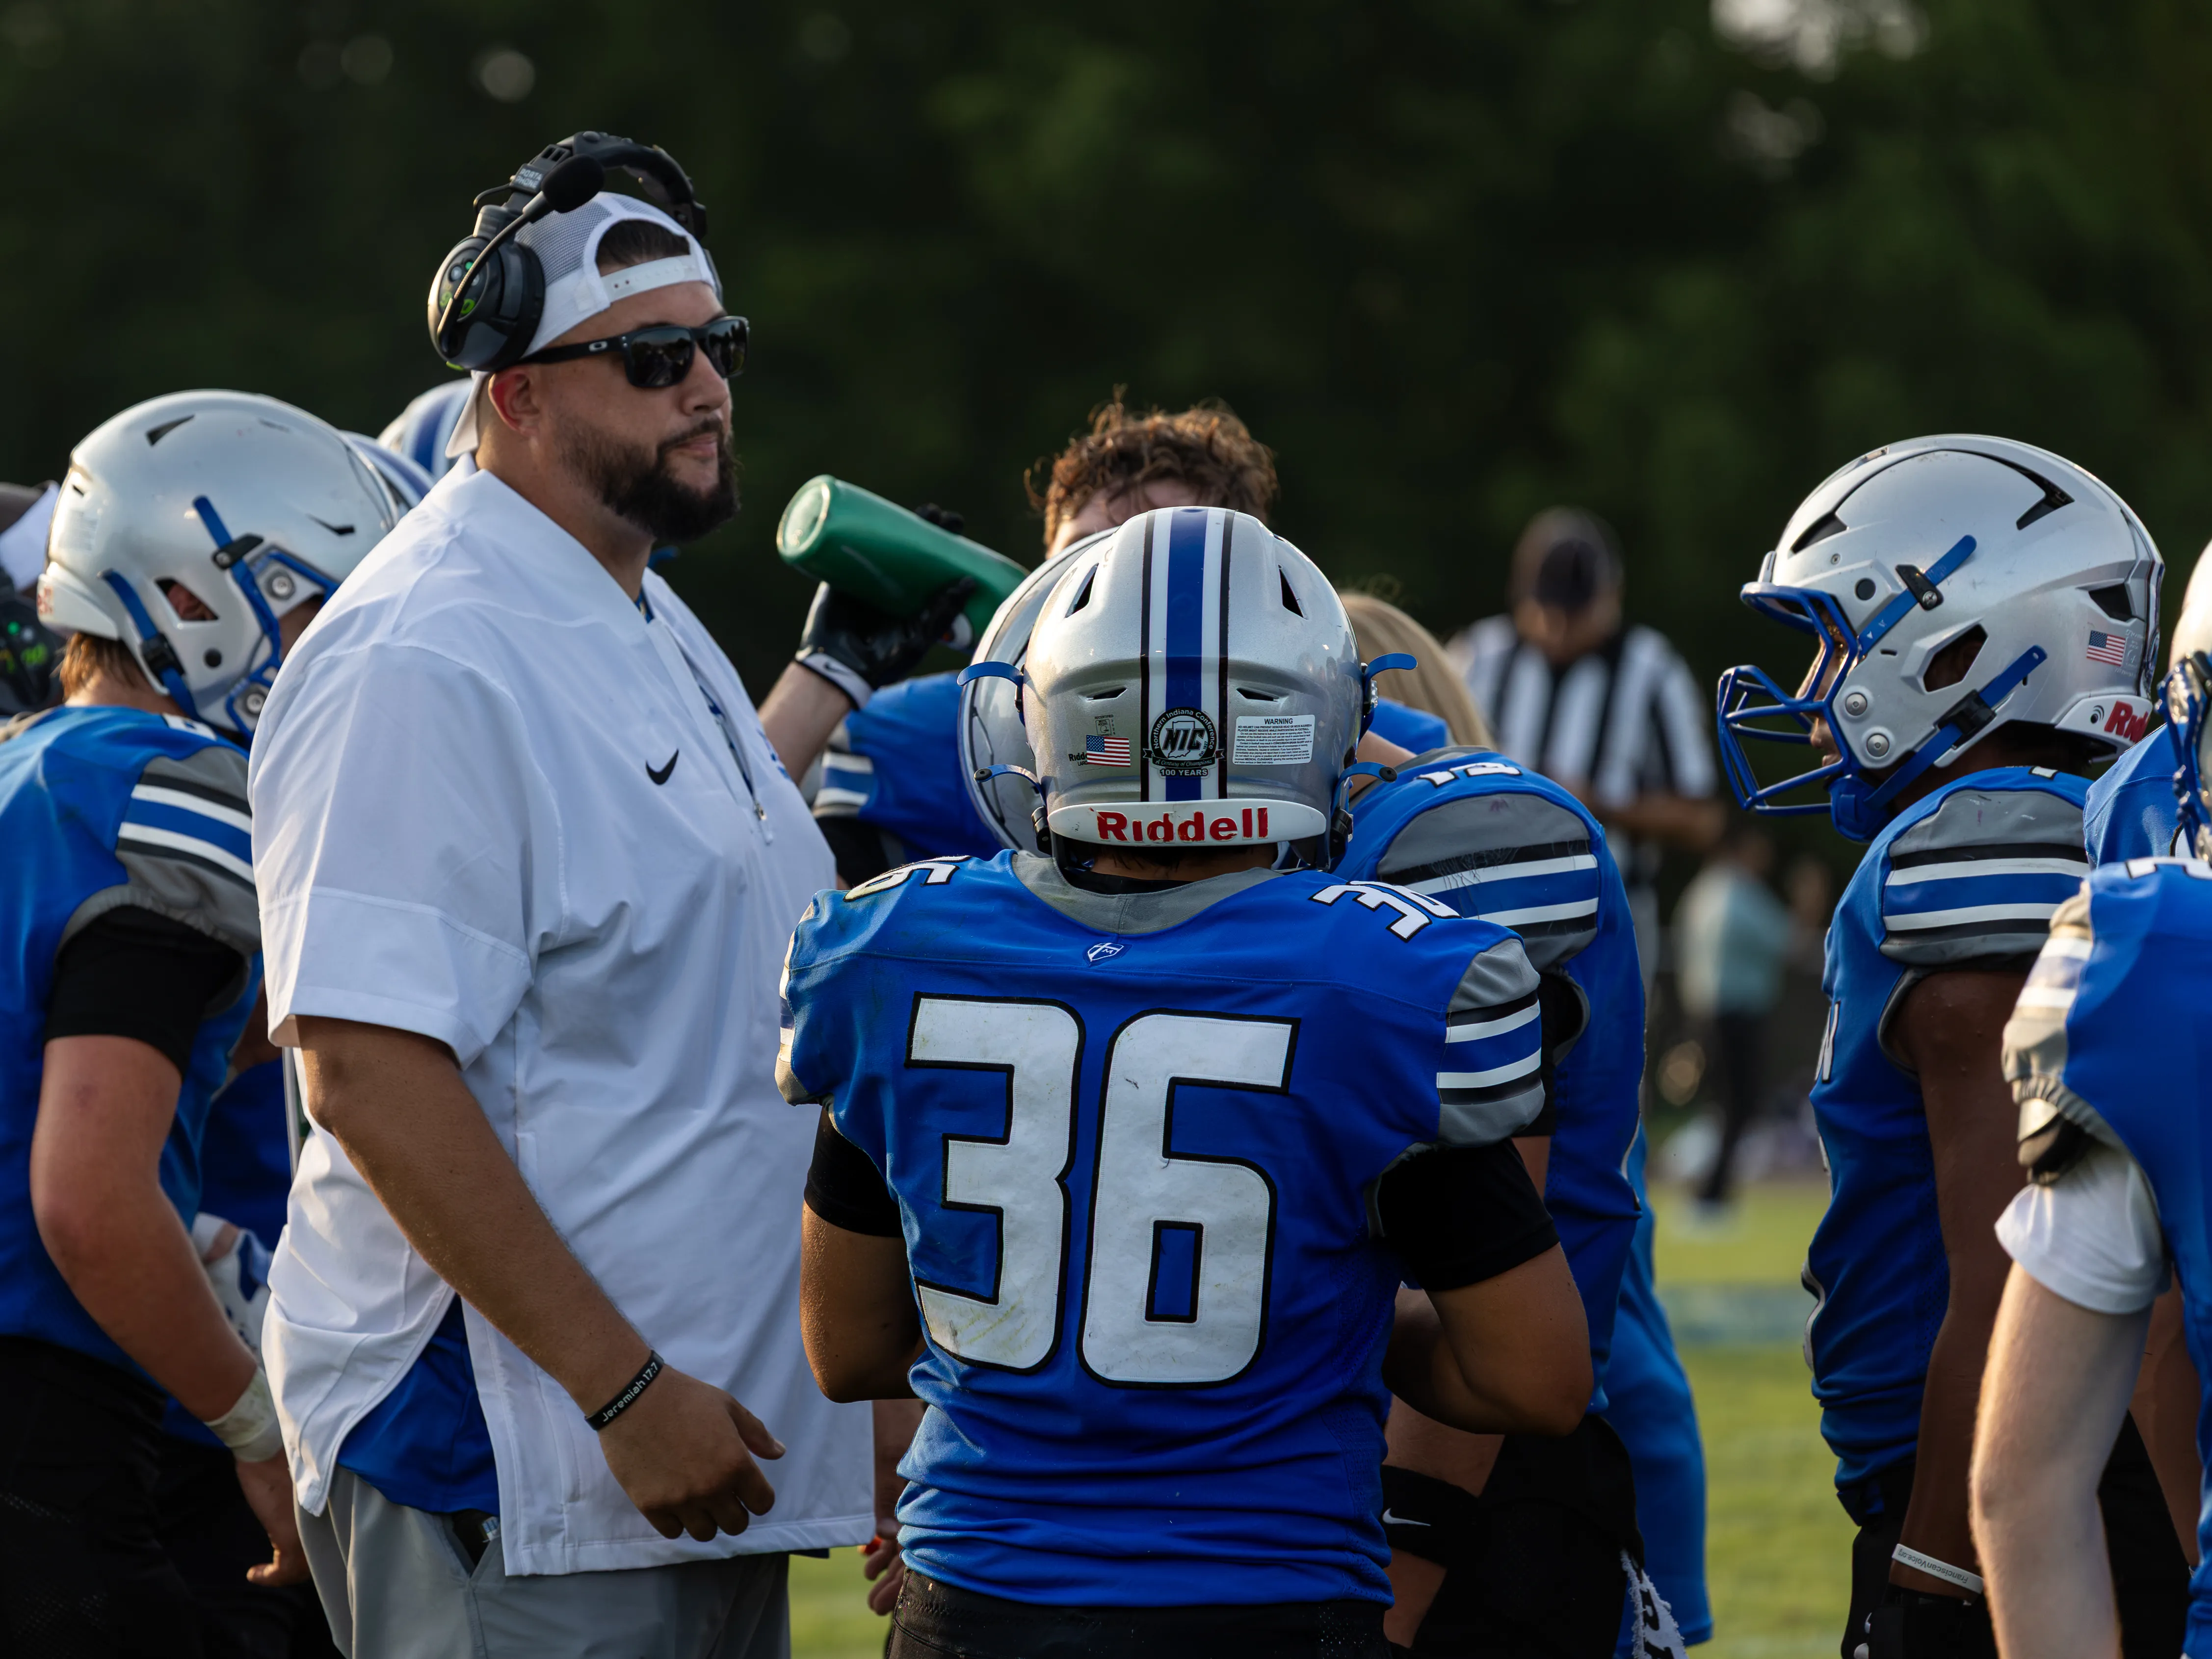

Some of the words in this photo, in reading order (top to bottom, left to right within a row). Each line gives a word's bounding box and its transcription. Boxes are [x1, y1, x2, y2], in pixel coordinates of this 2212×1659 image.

[1153, 716, 1166, 750] Northern
[1166, 709, 1193, 718] Indiana
[1195, 712, 1215, 750] Conference
[1162, 728, 1206, 751] NIC
[1096, 807, 1268, 843] Riddell
[904, 991, 1301, 1390] 36
[603, 1379, 646, 1422] Jeremiah
[642, 1362, 658, 1381] 17:7
[1897, 1549, 1969, 1584] FranciscanVoice.org
